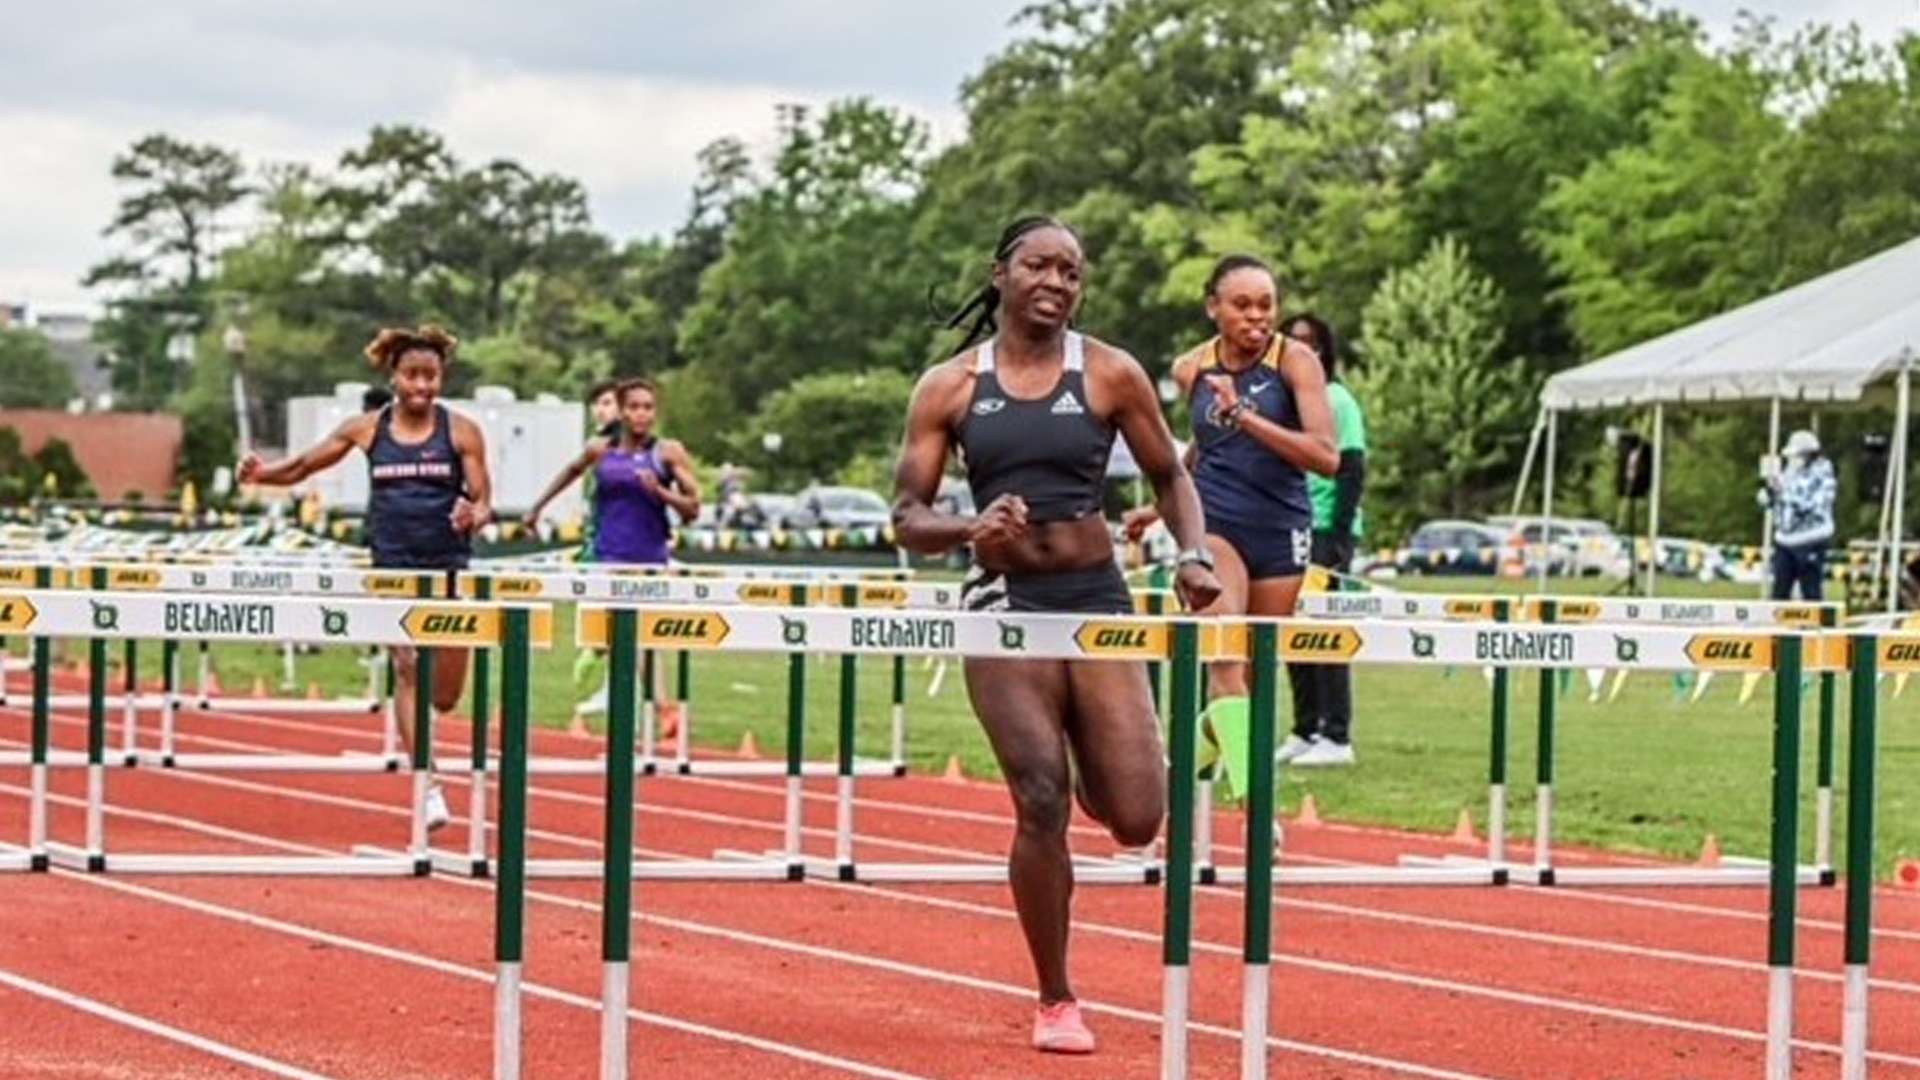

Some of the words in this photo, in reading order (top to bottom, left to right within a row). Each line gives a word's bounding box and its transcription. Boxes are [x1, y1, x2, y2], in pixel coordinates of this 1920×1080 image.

[422, 615, 477, 633] GILL
[652, 618, 707, 637] GILL
[1094, 629, 1147, 647] GILL
[1290, 633, 1342, 650] GILL
[1704, 641, 1752, 659] GILL
[1886, 644, 1920, 661] GIL
